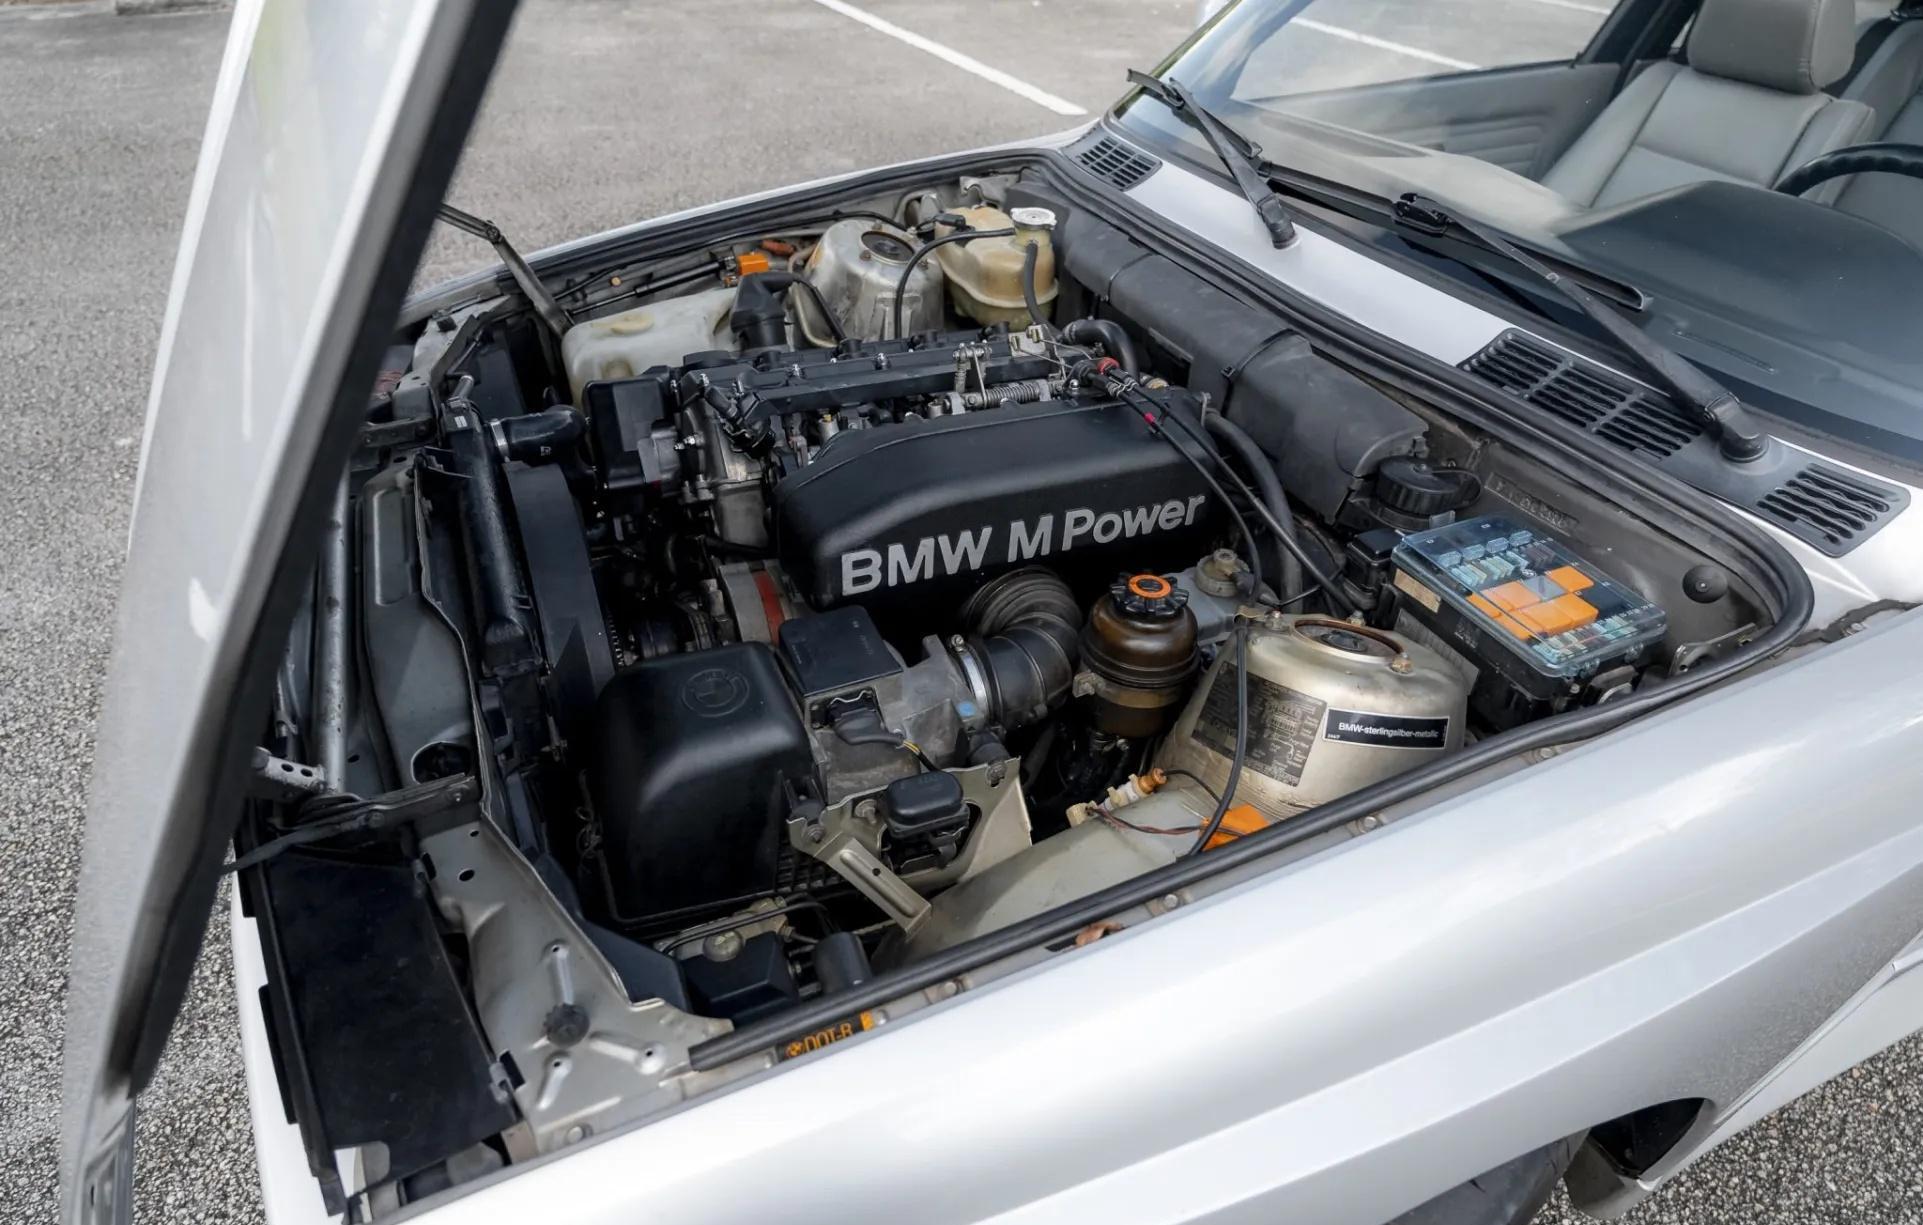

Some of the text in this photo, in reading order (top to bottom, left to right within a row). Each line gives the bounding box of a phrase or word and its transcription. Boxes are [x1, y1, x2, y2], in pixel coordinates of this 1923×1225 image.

[842, 495, 1207, 596] BMW M Power
